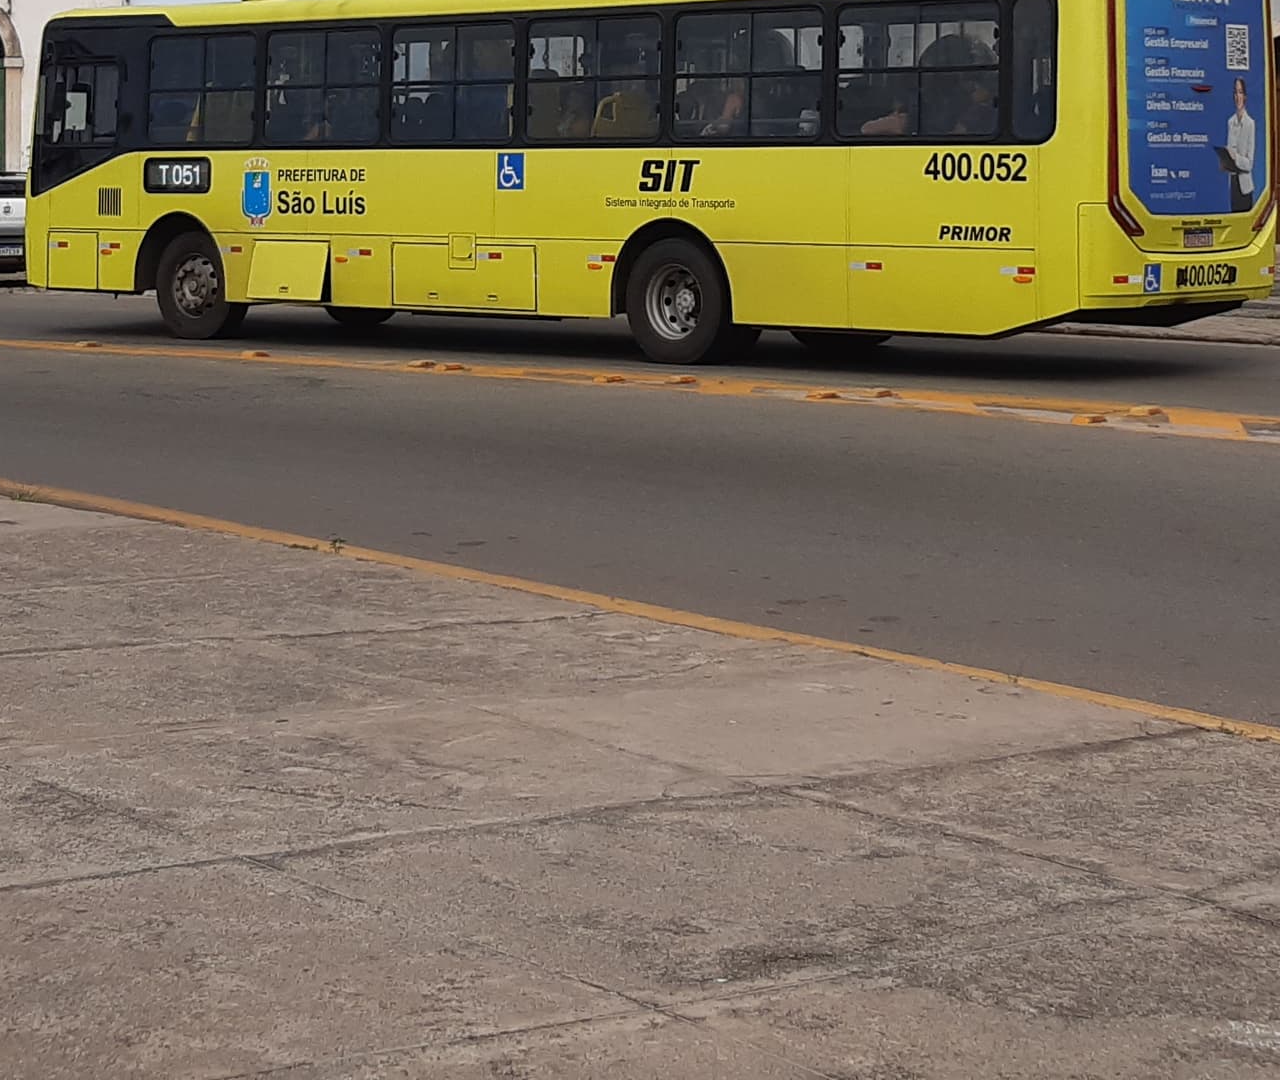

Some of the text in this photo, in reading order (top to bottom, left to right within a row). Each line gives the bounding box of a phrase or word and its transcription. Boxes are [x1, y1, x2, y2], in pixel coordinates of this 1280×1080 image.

[1144, 36, 1208, 49] Gestão Empresarial
[1145, 67, 1205, 77] Gestão Financeira
[1146, 100, 1204, 111] Direito Tributário
[1147, 132, 1208, 142] Gestão de Pessoas
[924, 152, 1028, 182] 400.052
[159, 164, 200, 185] T 051
[277, 169, 366, 182] PREFEITURA DE
[639, 159, 701, 192] SIT
[277, 190, 366, 215] São Luís
[605, 197, 637, 208] Sistema
[679, 198, 689, 208] de
[691, 198, 736, 210] Transporte
[939, 225, 1011, 242] PRIMOR
